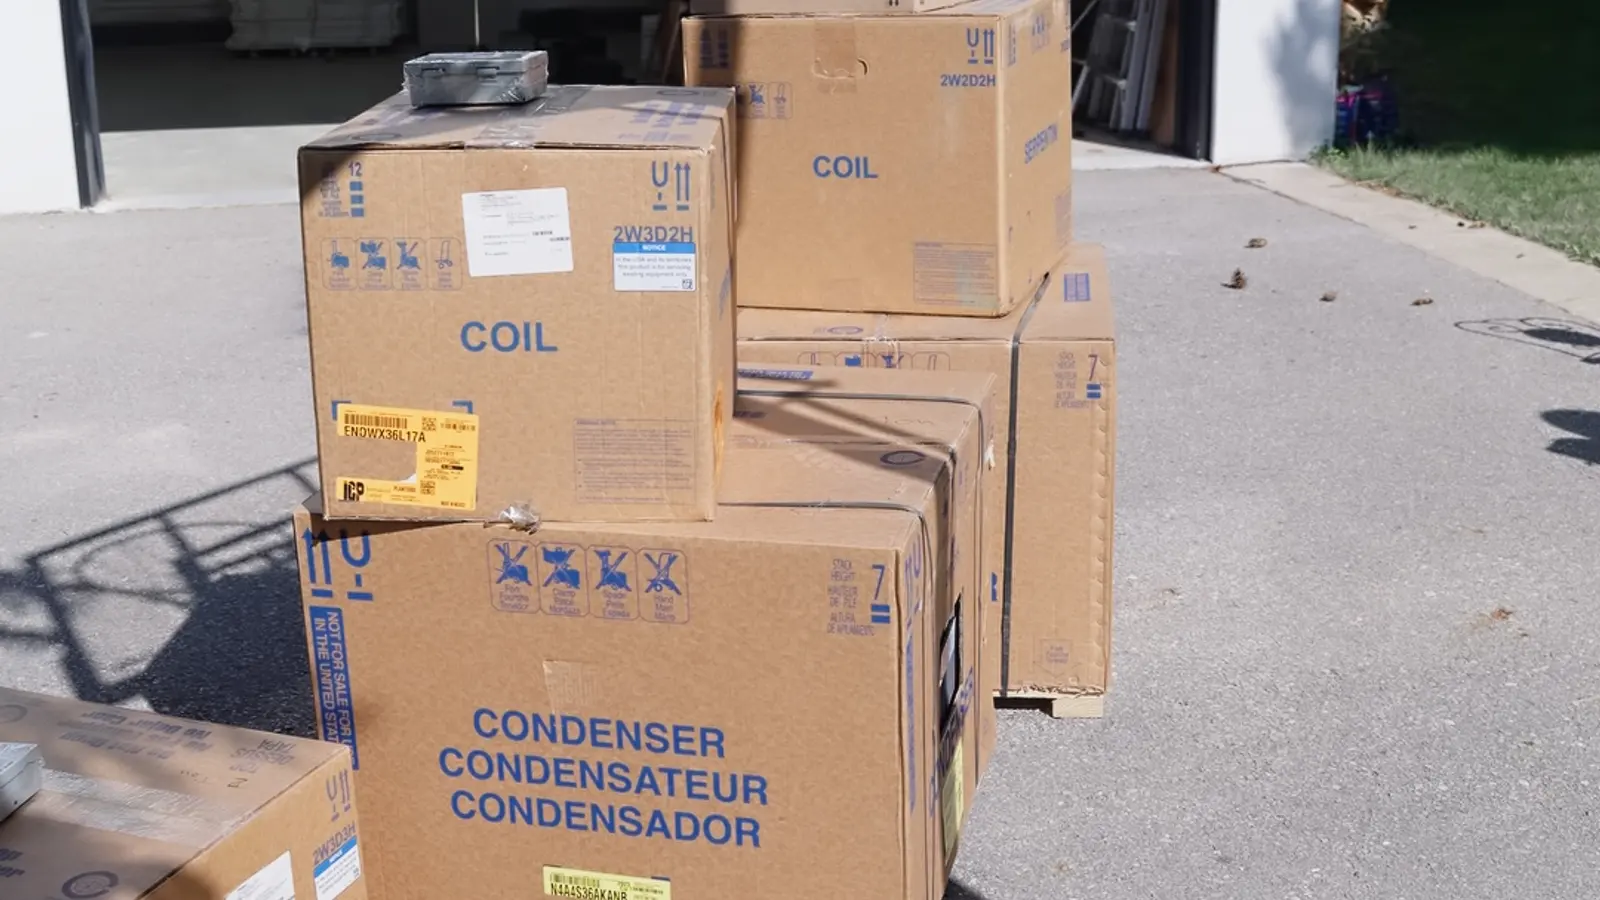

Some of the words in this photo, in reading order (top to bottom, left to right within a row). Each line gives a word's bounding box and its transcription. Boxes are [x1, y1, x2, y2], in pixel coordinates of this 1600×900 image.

[940, 73, 997, 87] 2W2D2H
[348, 161, 362, 177] 12
[813, 155, 879, 179] COIL
[614, 225, 694, 243] 2W3D2H
[642, 243, 667, 252] NOTICE
[460, 321, 558, 352] COIL
[1088, 353, 1098, 381] 7
[343, 481, 365, 502] ICP
[872, 563, 885, 600] 7
[313, 617, 326, 632] IN
[326, 611, 342, 642] NOT
[316, 634, 330, 661] THE
[331, 642, 343, 670] FOR
[319, 663, 336, 710] UNITED
[333, 672, 348, 707] SALE
[324, 711, 339, 744] STAT
[338, 709, 351, 736] FOR
[473, 707, 726, 758] CONDENSER
[439, 747, 768, 805] CONDENSATEUR
[450, 789, 761, 848] CONDENSADOR
